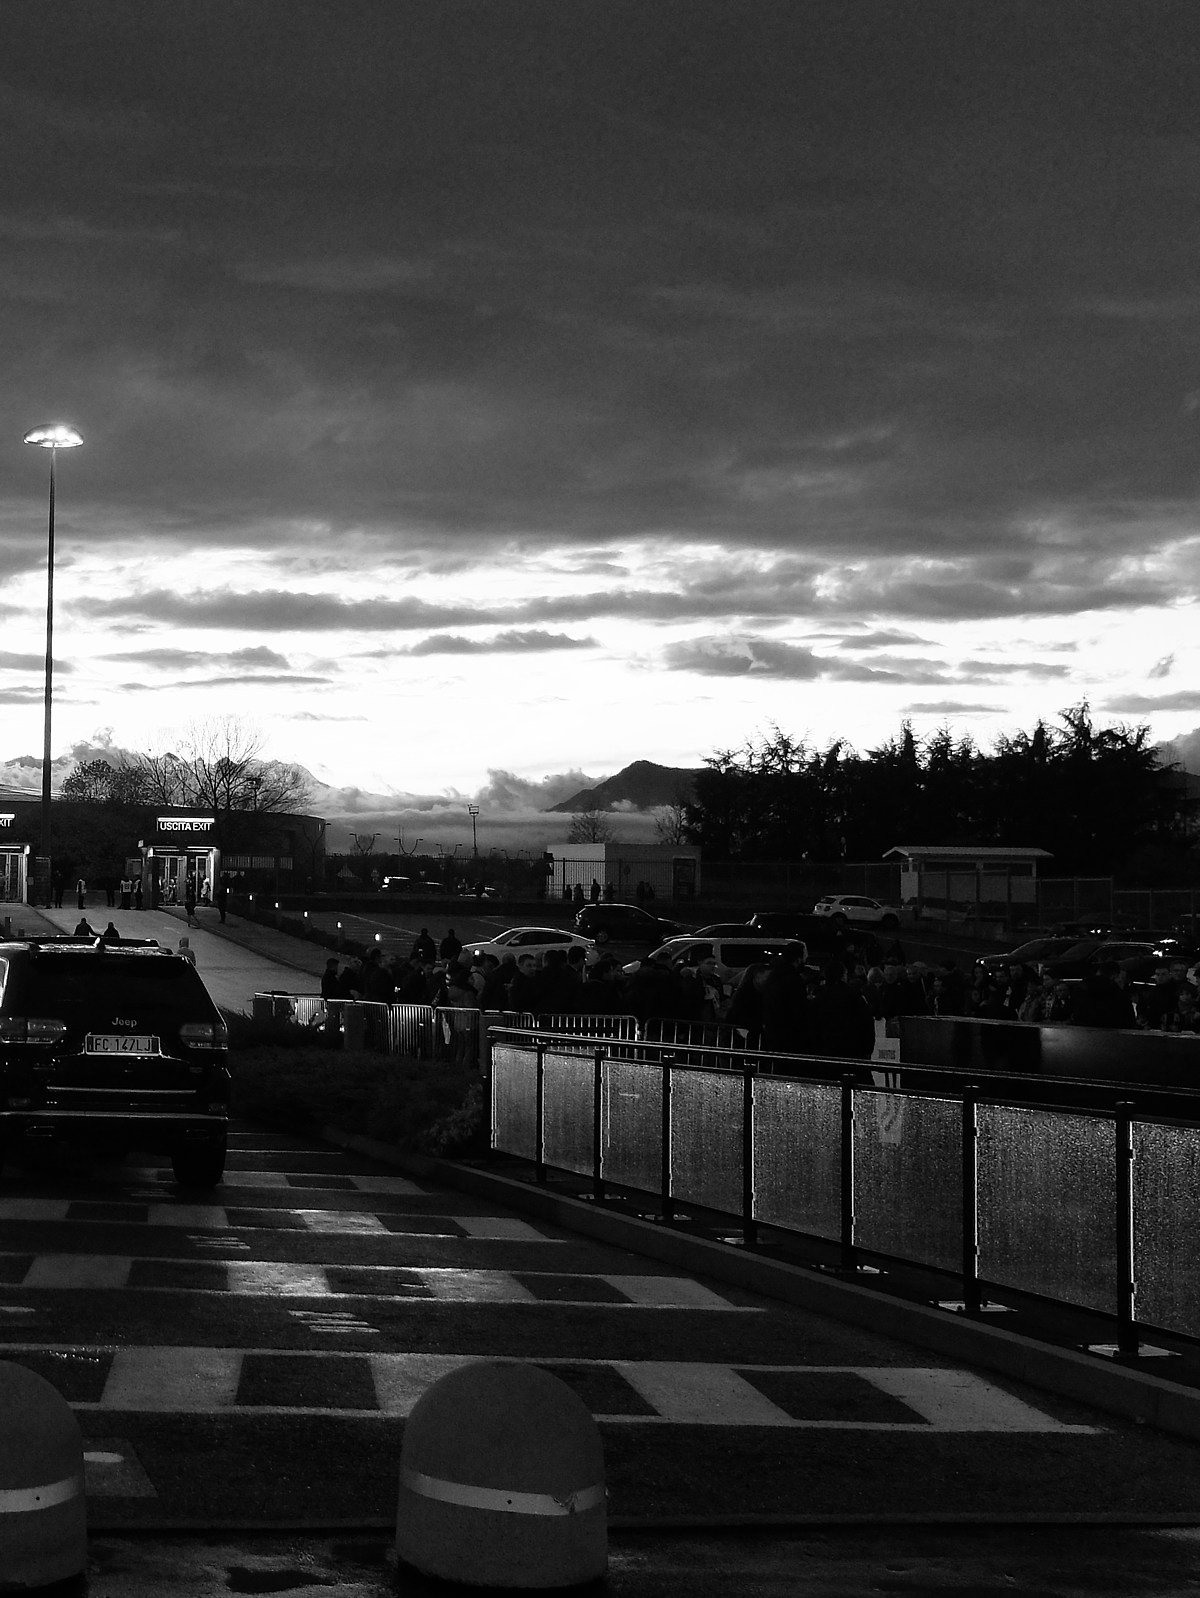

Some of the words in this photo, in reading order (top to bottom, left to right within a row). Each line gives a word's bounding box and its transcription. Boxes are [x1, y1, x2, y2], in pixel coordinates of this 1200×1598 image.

[160, 821, 192, 831] USCITA
[193, 822, 213, 831] EXIT
[111, 1016, 138, 1028] Jeep
[94, 1038, 109, 1051] FC
